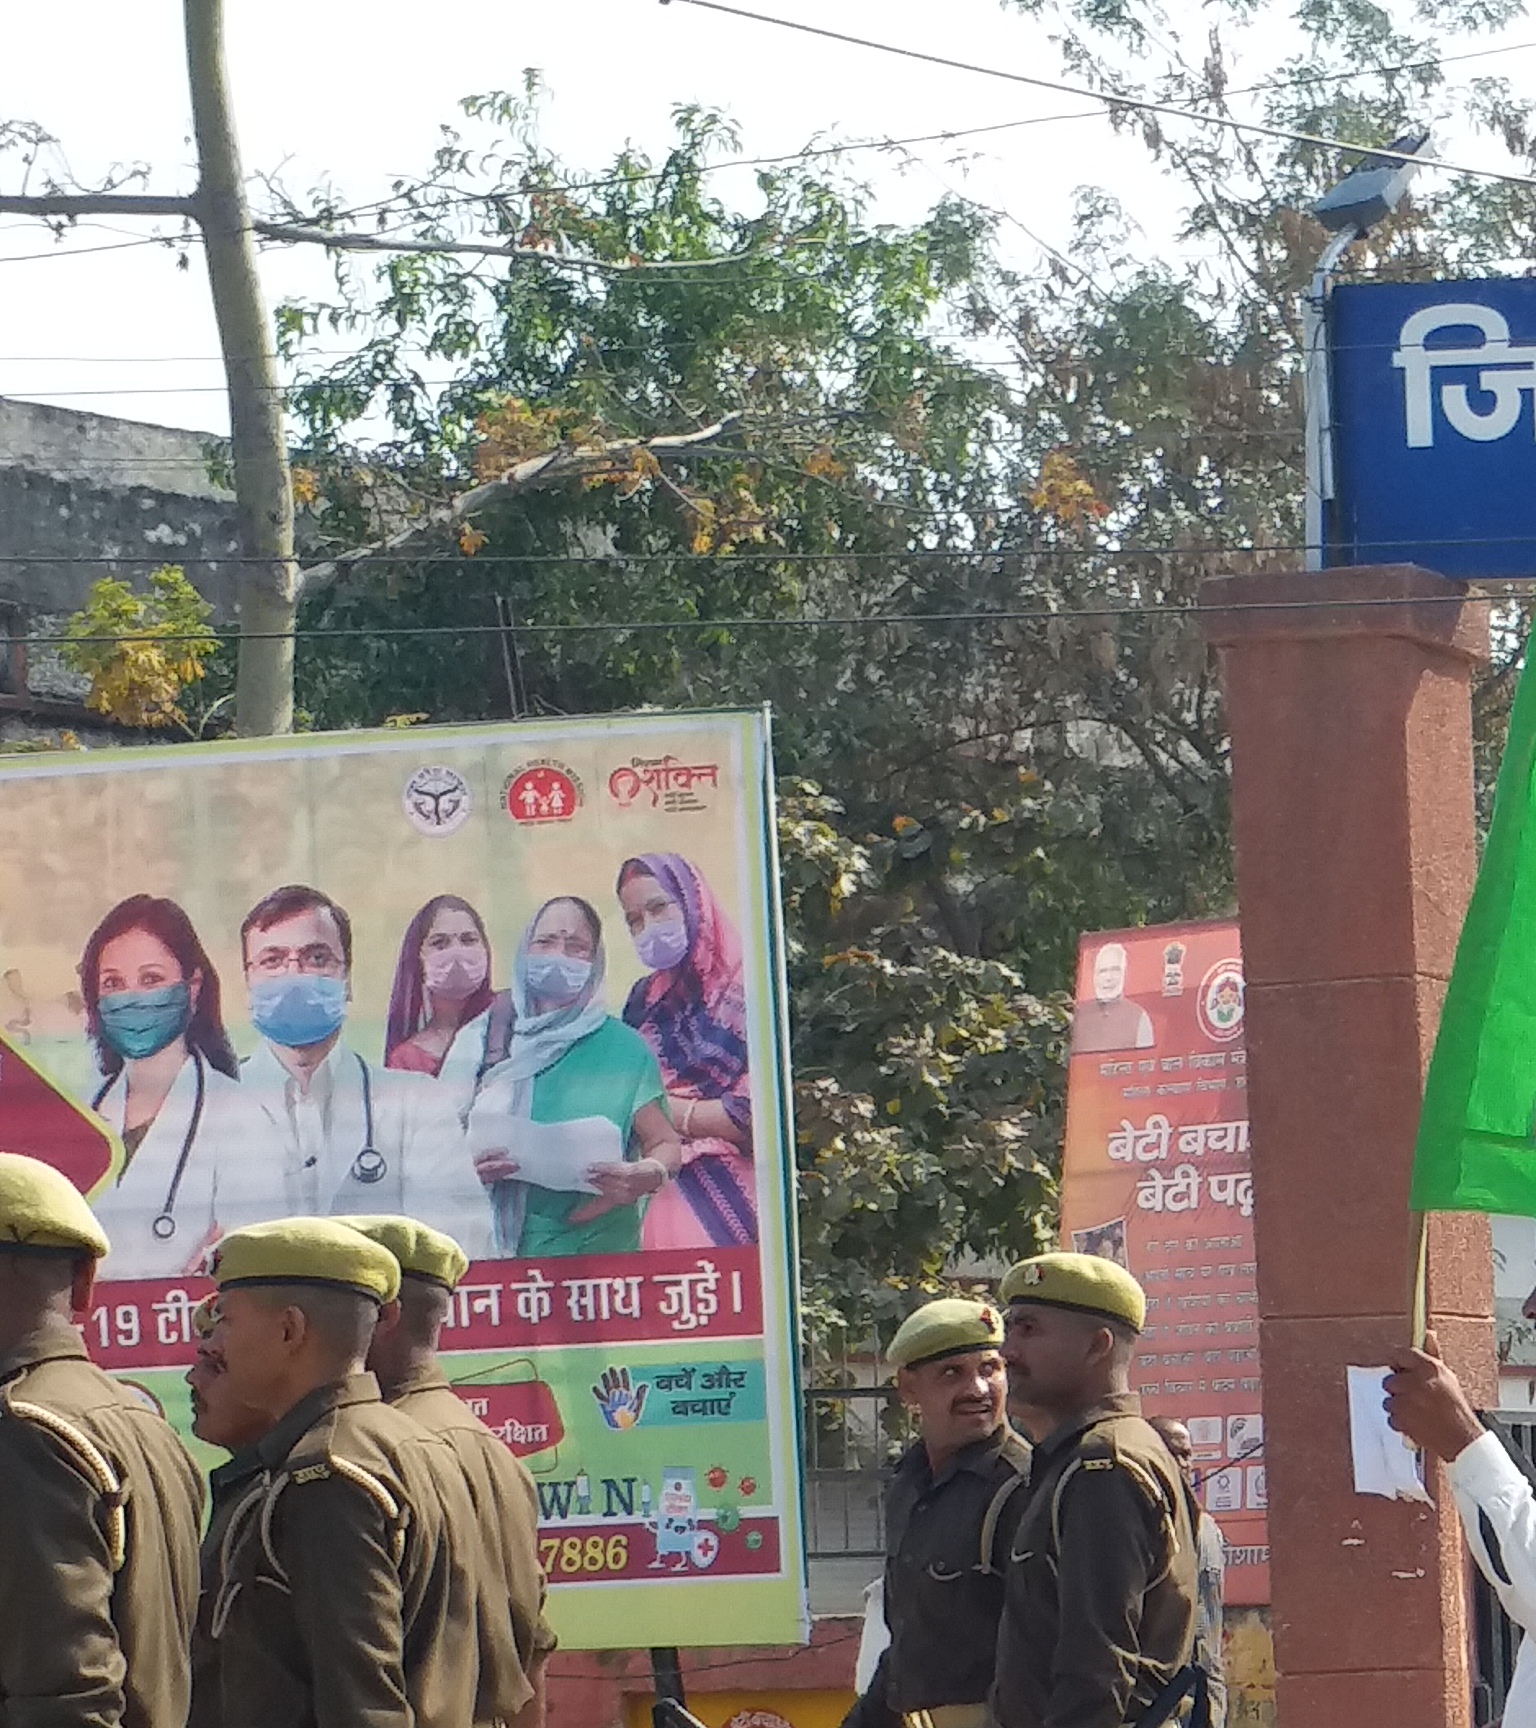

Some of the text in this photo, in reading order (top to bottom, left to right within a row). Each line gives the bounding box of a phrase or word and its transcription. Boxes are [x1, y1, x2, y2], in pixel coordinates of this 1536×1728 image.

[1108, 1114, 1251, 1162] बेटी बचा
[1136, 1163, 1203, 1213] बेटी
[510, 1269, 554, 1325] के
[562, 1276, 644, 1322] साथ
[539, 1534, 628, 1574] 7886
